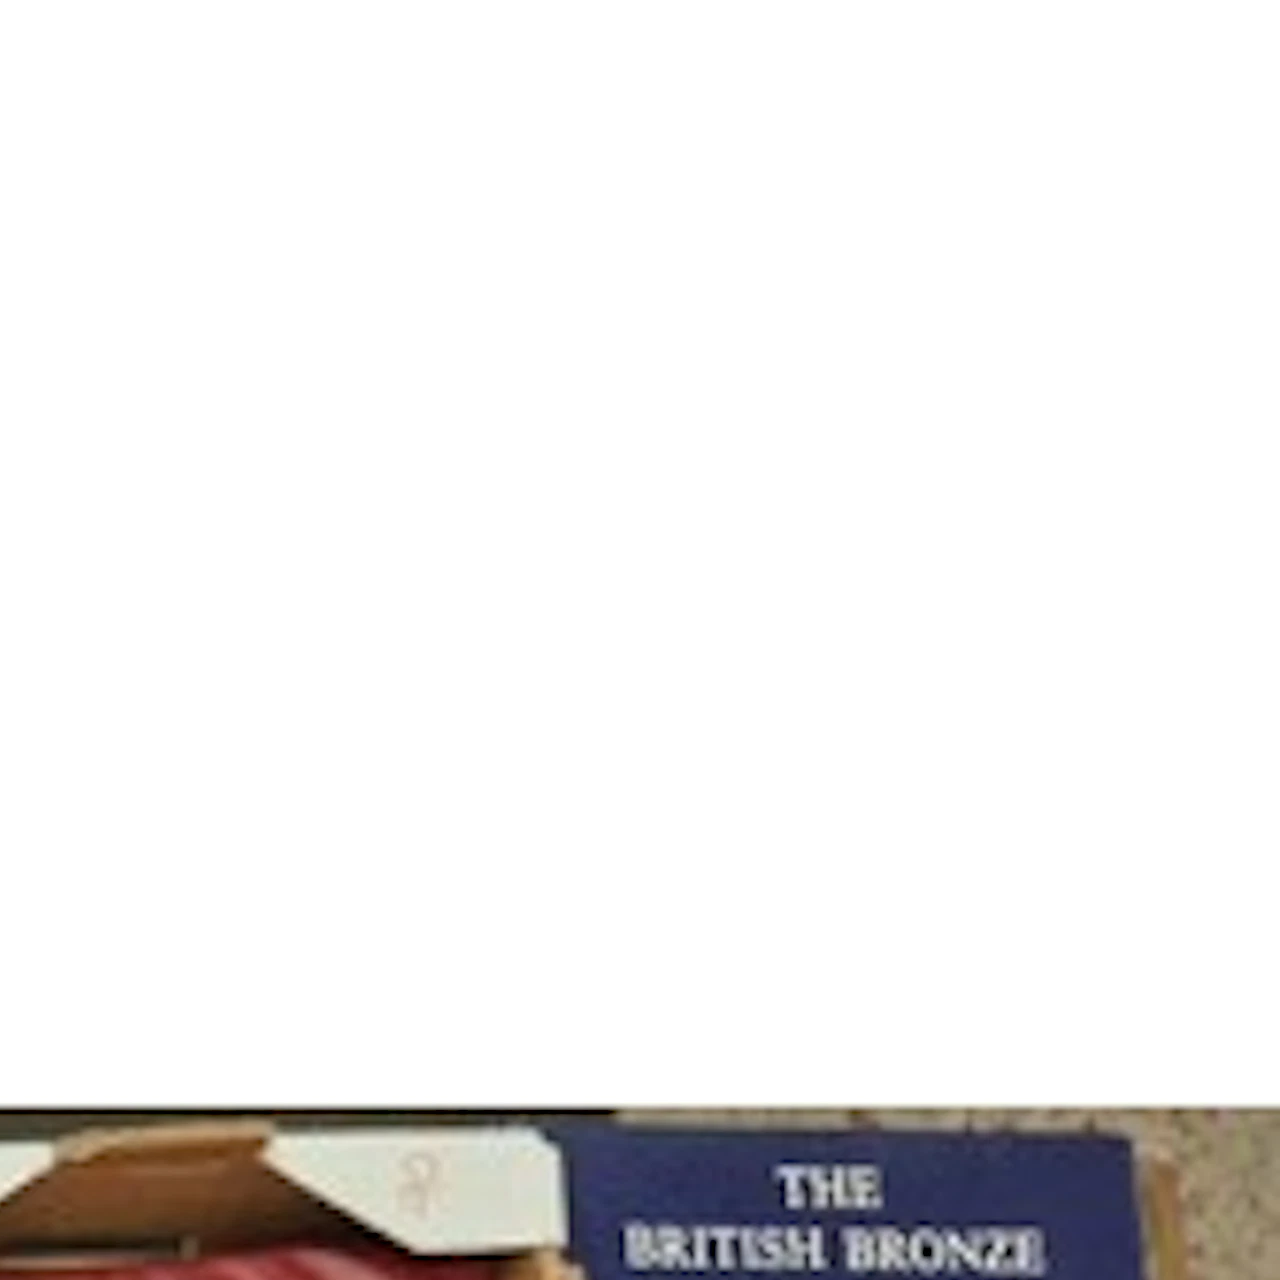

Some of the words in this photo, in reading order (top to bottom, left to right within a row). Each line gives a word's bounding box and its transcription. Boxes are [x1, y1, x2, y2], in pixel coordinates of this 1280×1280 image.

[775, 1163, 884, 1210] THE
[623, 1224, 827, 1272] BRITISH
[842, 1225, 1047, 1277] BRONZE
